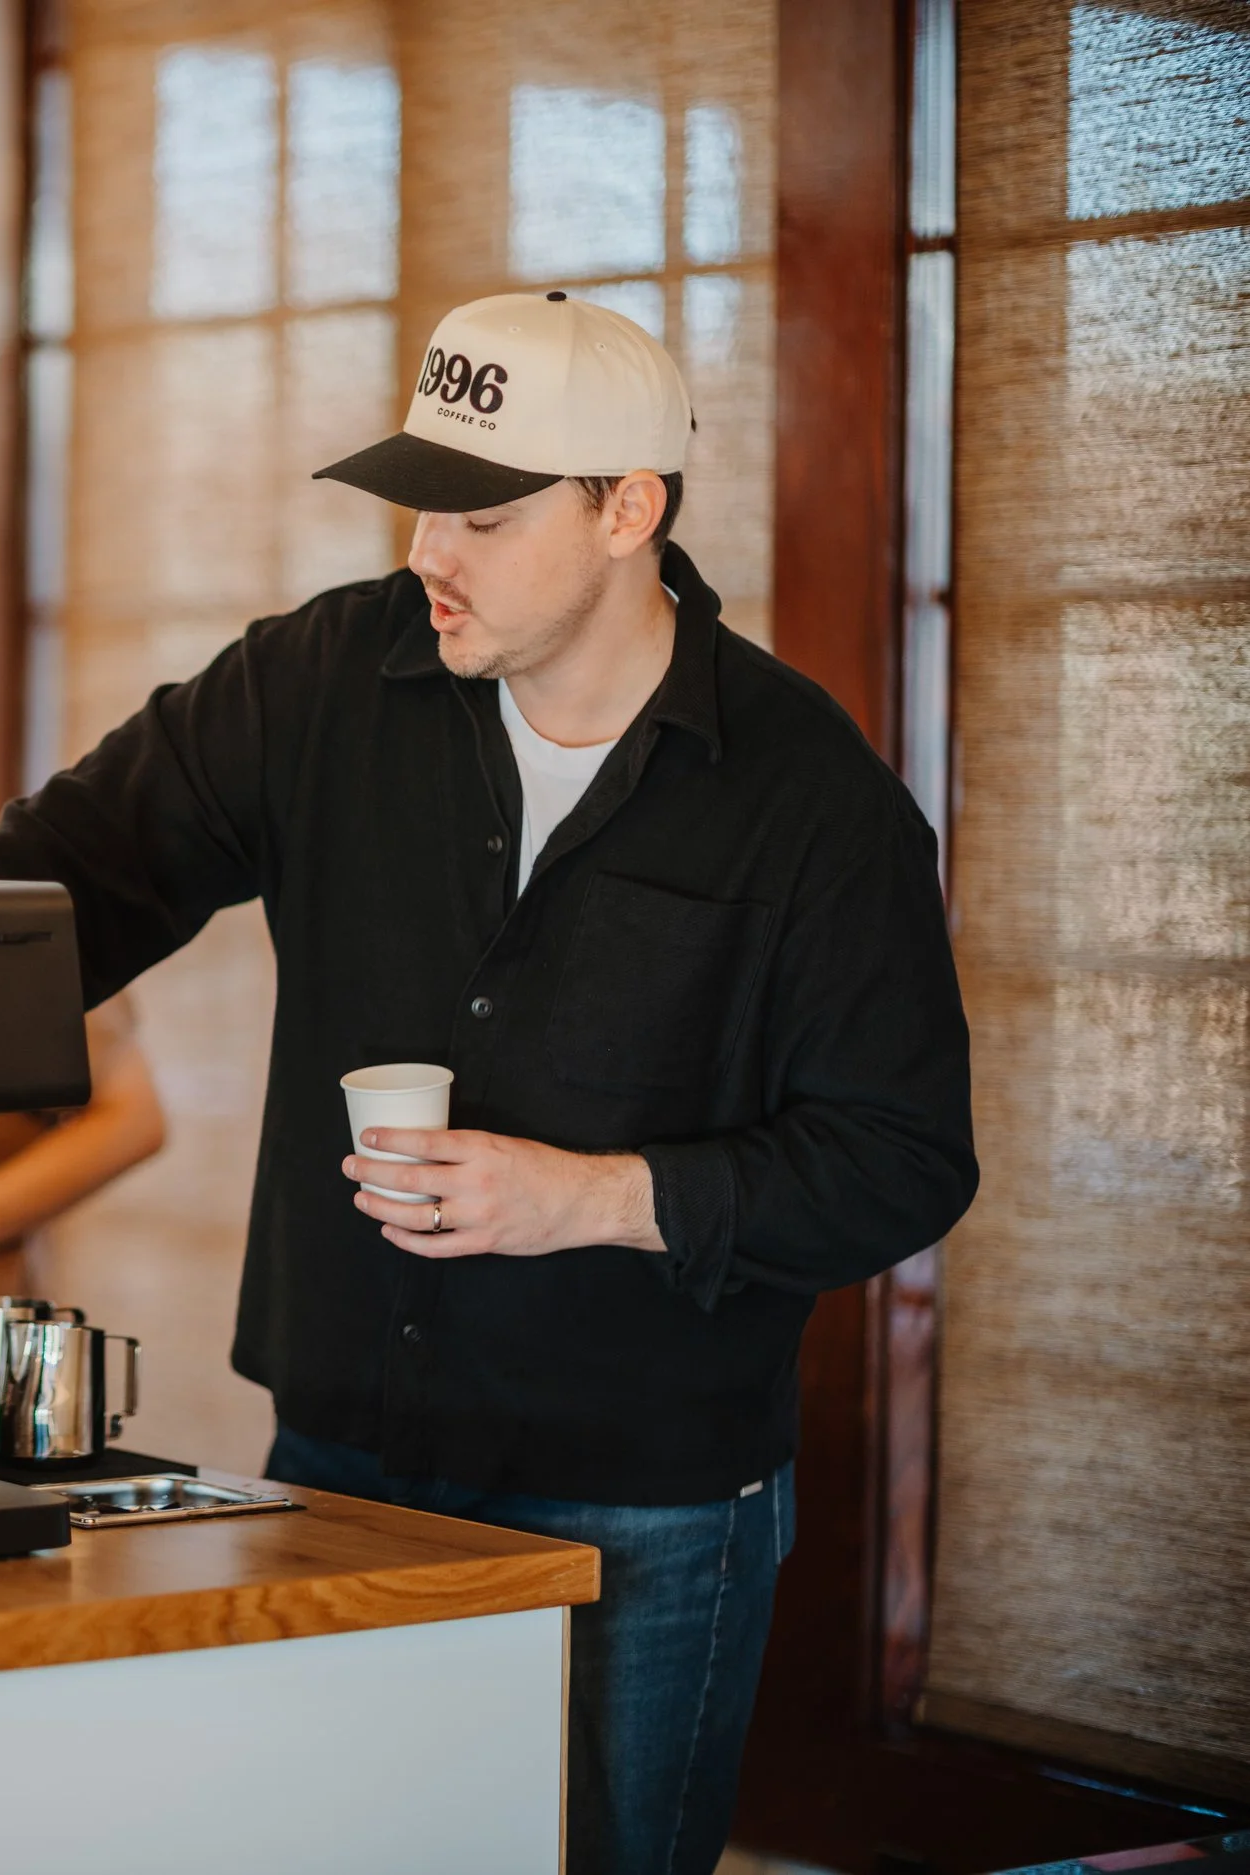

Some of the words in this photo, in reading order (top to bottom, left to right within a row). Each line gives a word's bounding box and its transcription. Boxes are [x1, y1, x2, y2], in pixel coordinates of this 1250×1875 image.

[418, 346, 508, 414] 1996
[437, 407, 475, 425] COFFEE
[479, 420, 496, 431] CO
